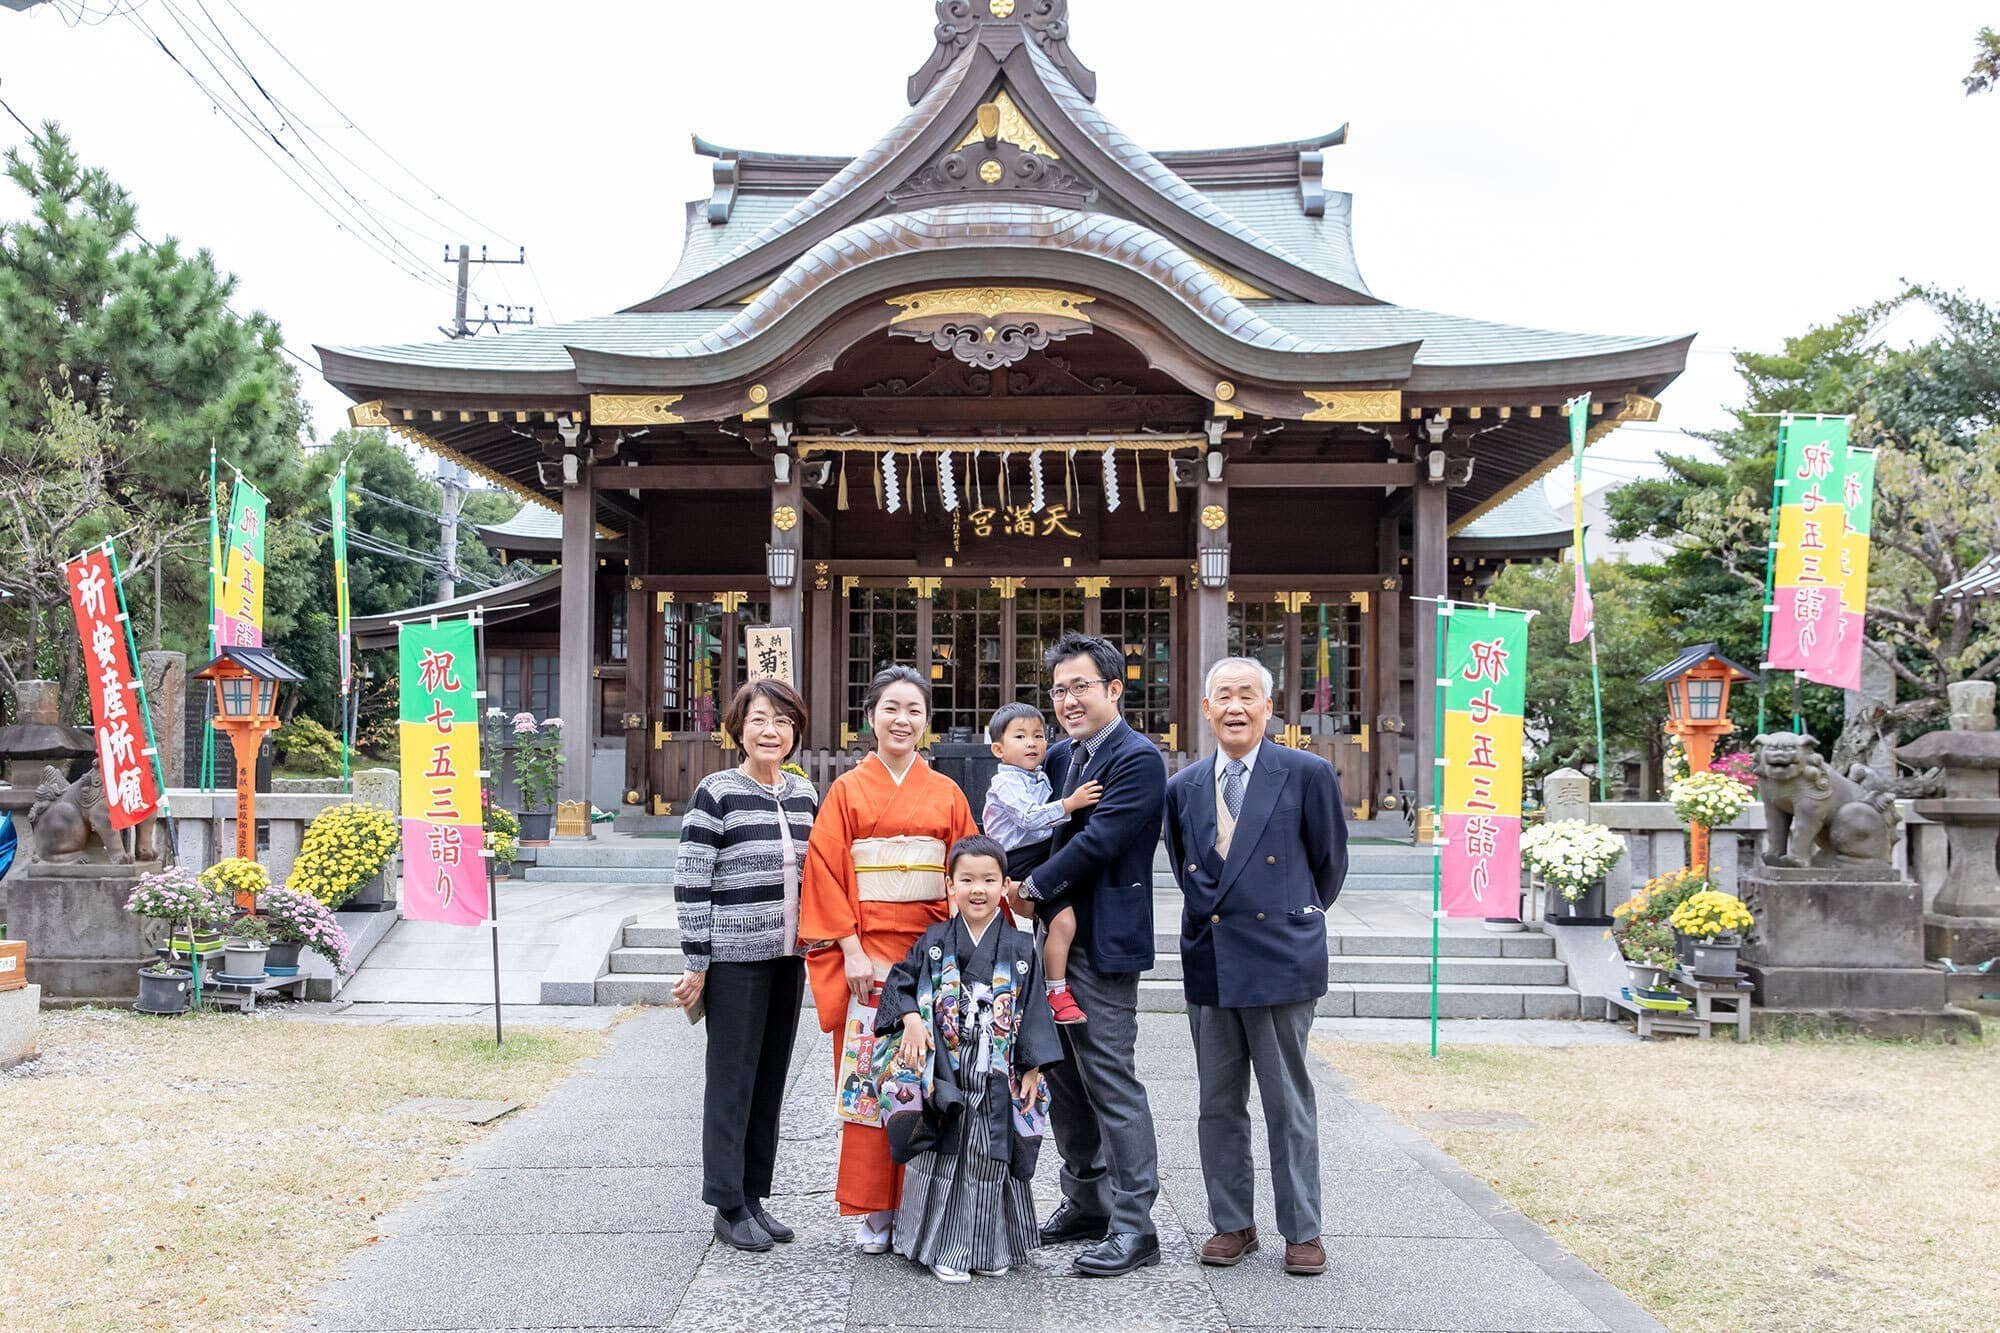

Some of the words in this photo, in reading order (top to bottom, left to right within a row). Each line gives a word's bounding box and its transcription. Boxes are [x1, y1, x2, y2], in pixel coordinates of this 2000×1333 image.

[76, 564, 149, 814] 祈安産祈願
[418, 647, 461, 908] 祝七五三詣り
